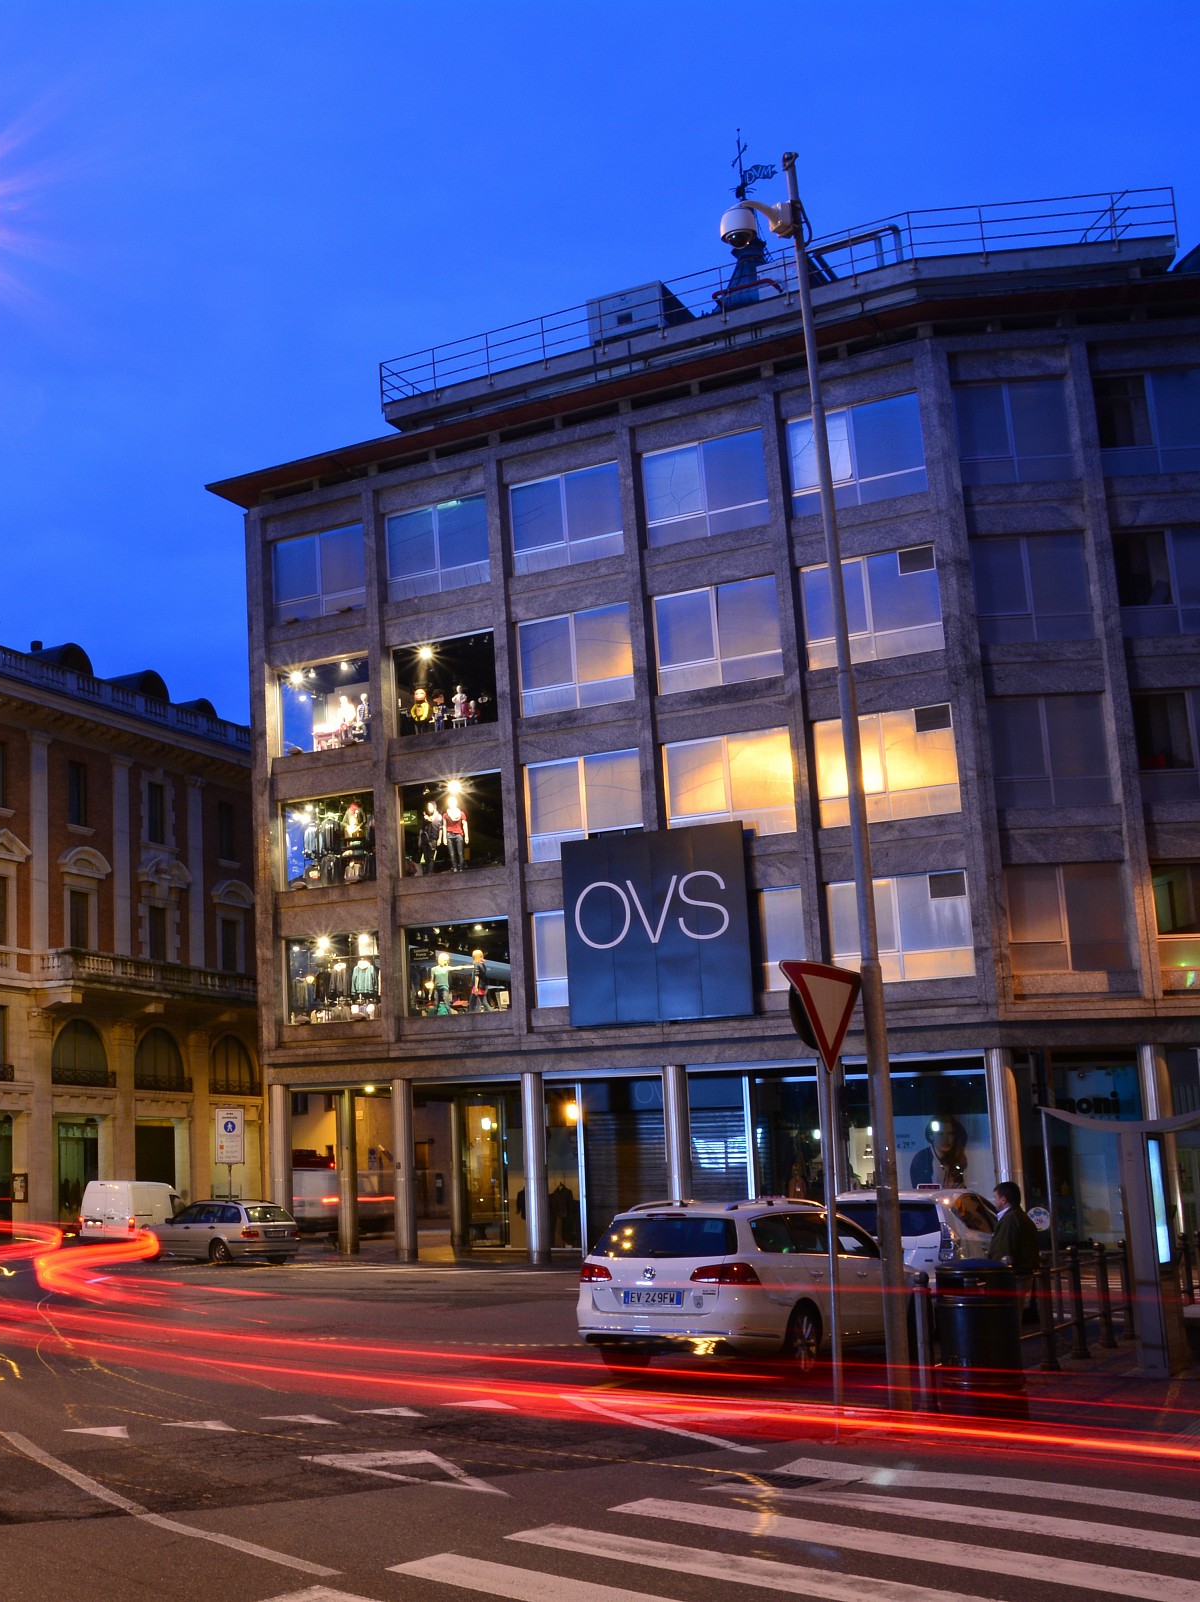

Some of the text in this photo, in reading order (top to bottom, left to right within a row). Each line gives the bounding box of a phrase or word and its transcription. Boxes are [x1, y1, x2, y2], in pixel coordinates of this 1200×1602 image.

[574, 870, 730, 950] OVS
[630, 1291, 676, 1304] EV 249FW
